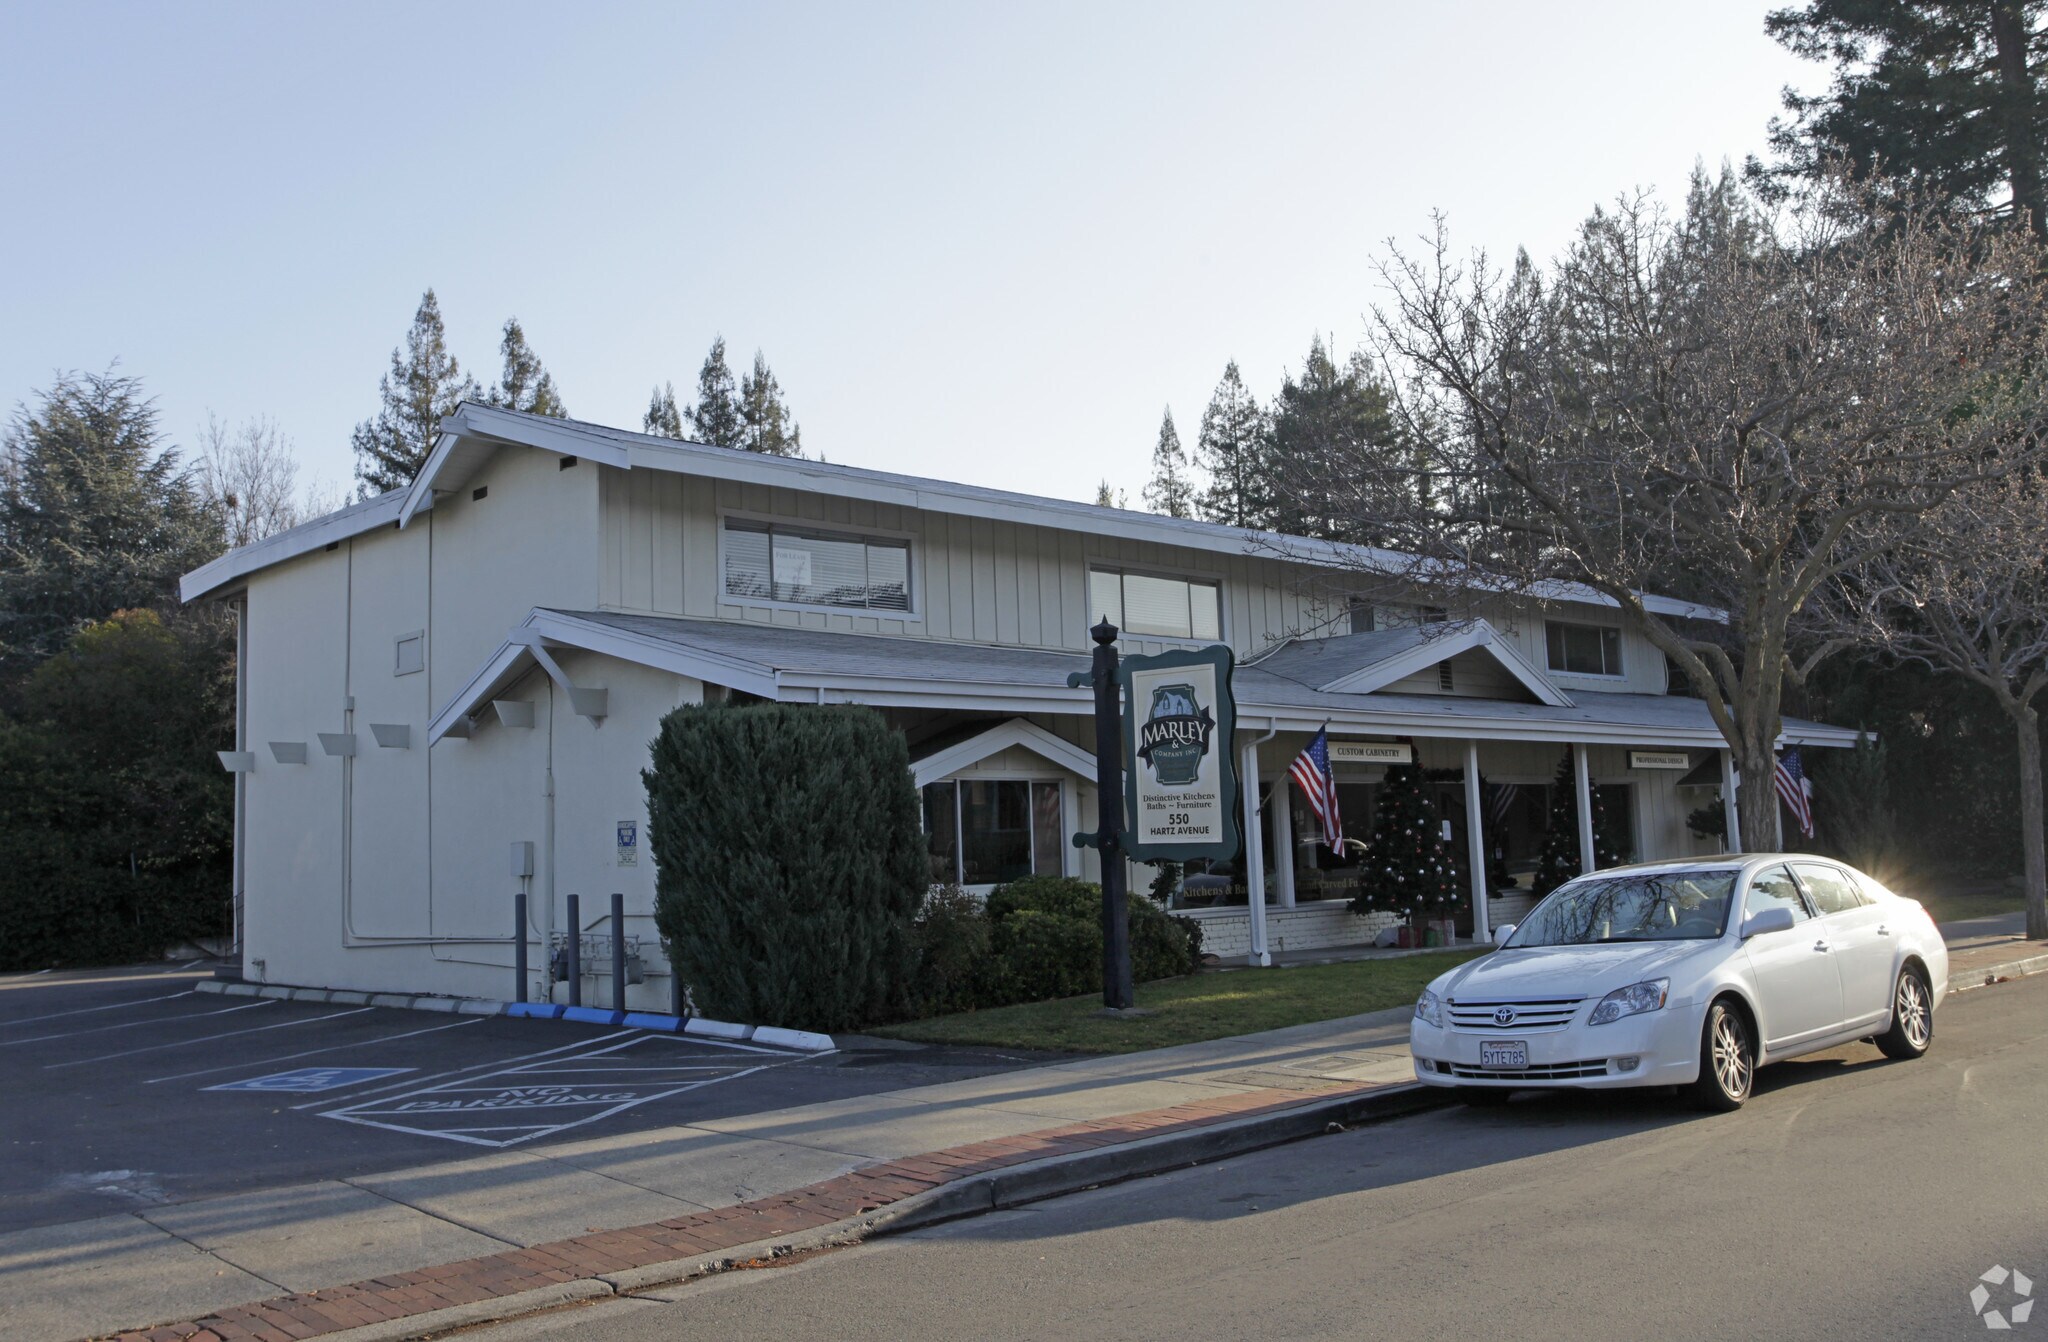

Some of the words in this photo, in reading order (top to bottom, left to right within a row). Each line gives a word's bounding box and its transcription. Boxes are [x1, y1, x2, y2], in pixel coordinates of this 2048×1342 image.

[1144, 720, 1206, 748] MARLEY
[1172, 740, 1179, 749] &
[1154, 749, 1183, 757] COMPANY
[1337, 747, 1364, 756] CUSTOM
[1366, 748, 1400, 758] CABINETRY
[1143, 794, 1181, 802] Distinctive
[1183, 792, 1216, 801] Kitchens
[1147, 802, 1166, 810] Baths
[1176, 801, 1212, 809] Furniture
[1169, 813, 1189, 825] 550
[1150, 827, 1175, 835] HARTZ
[1177, 826, 1210, 835] AVENUE
[1183, 885, 1223, 898] Kitchens
[1225, 884, 1233, 895] &
[1483, 1051, 1525, 1065] 5YTE785
[496, 1087, 573, 1098] NO
[395, 1092, 638, 1111] PARKING
